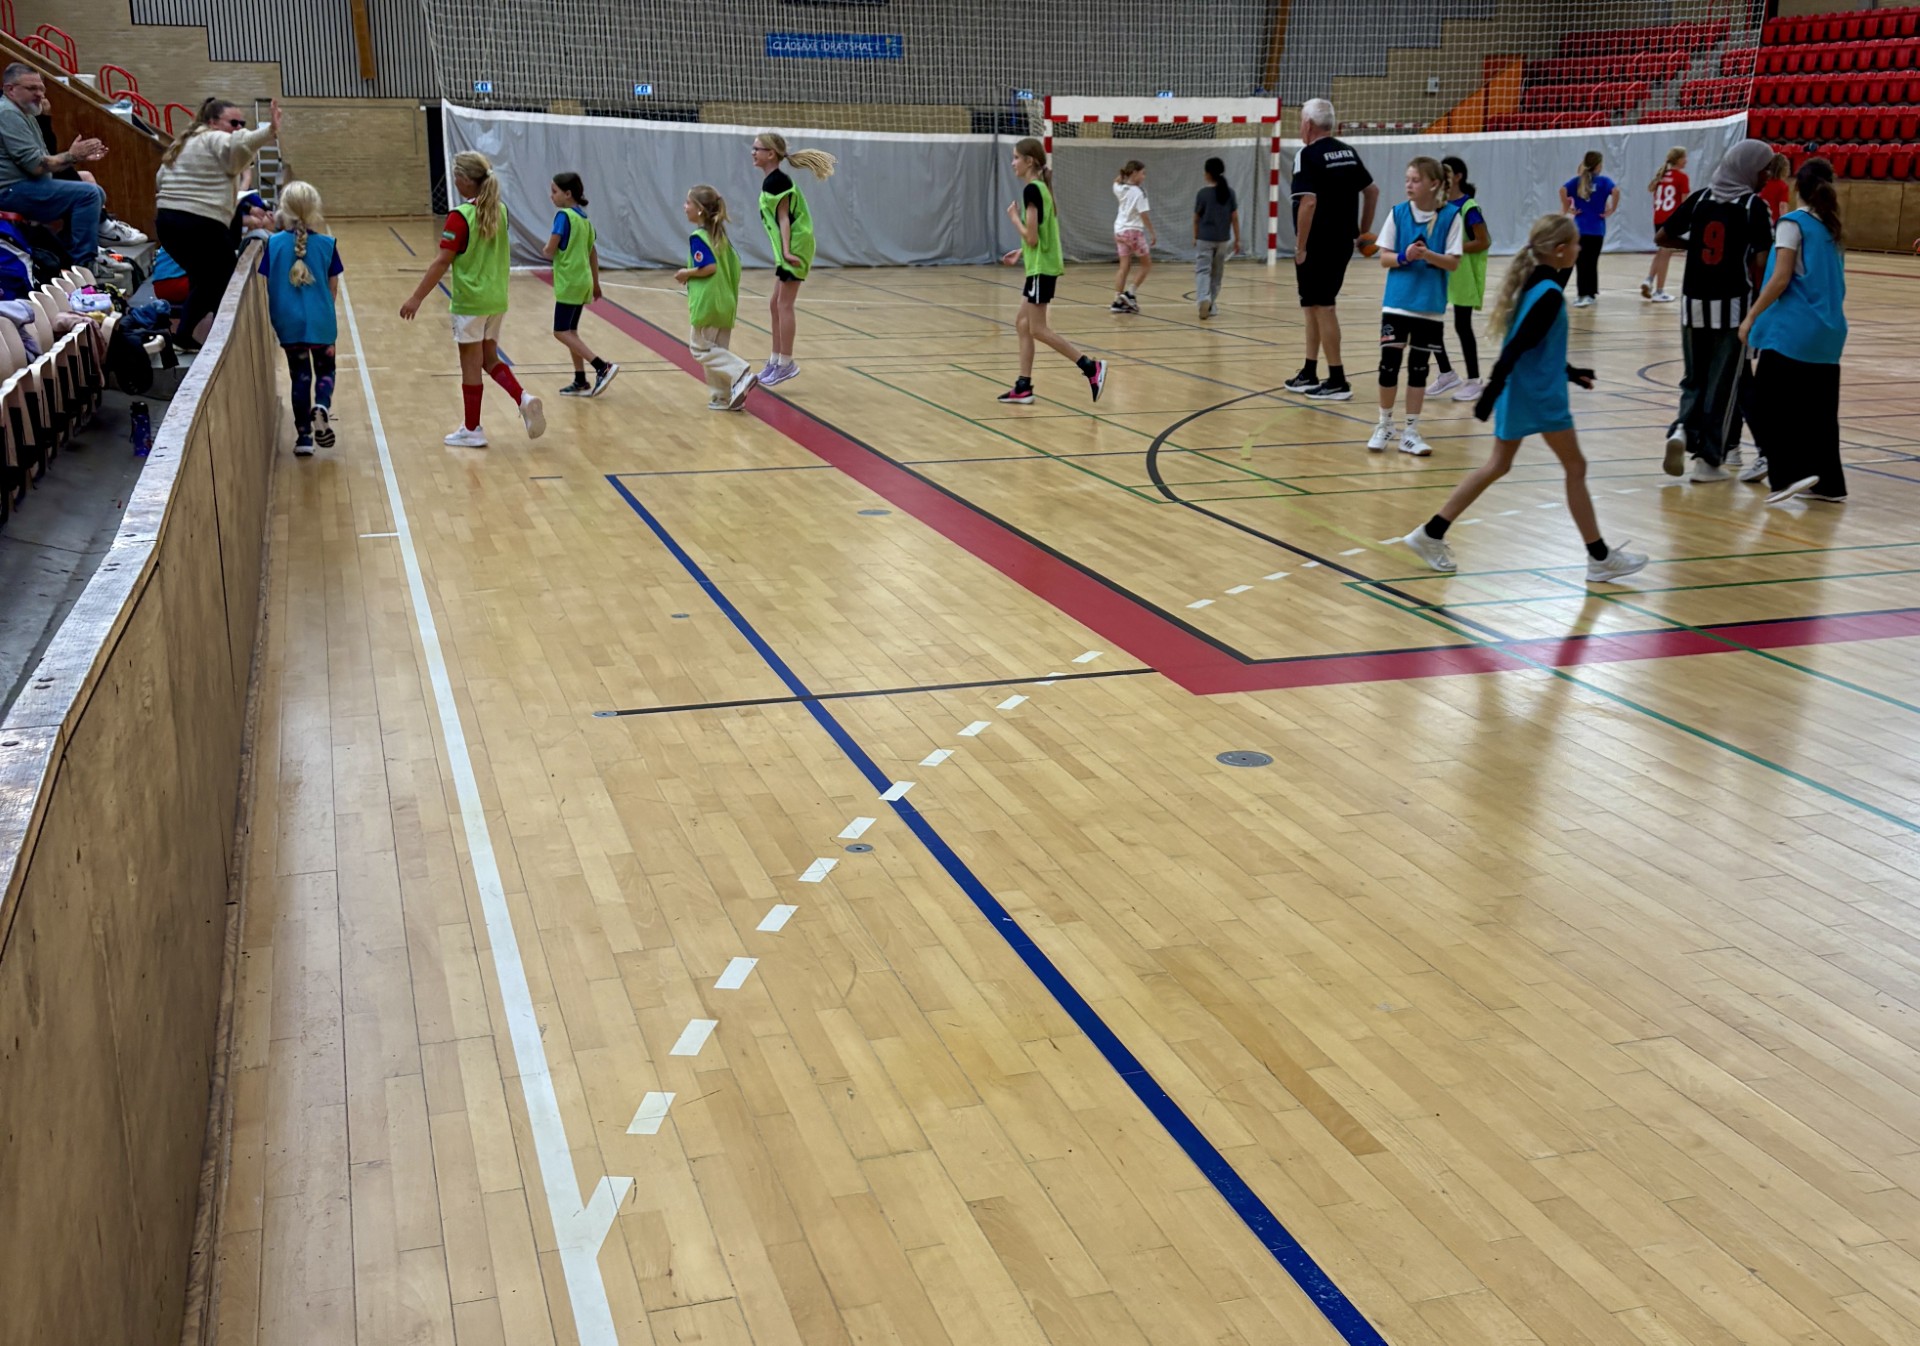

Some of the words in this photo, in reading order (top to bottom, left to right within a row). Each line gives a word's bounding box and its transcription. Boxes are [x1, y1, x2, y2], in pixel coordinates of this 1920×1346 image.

[772, 41, 818, 51] GLADSAXE
[820, 42, 873, 51] IDRÆTSHAL
[1655, 184, 1677, 212] 48
[1702, 221, 1726, 266] 9
